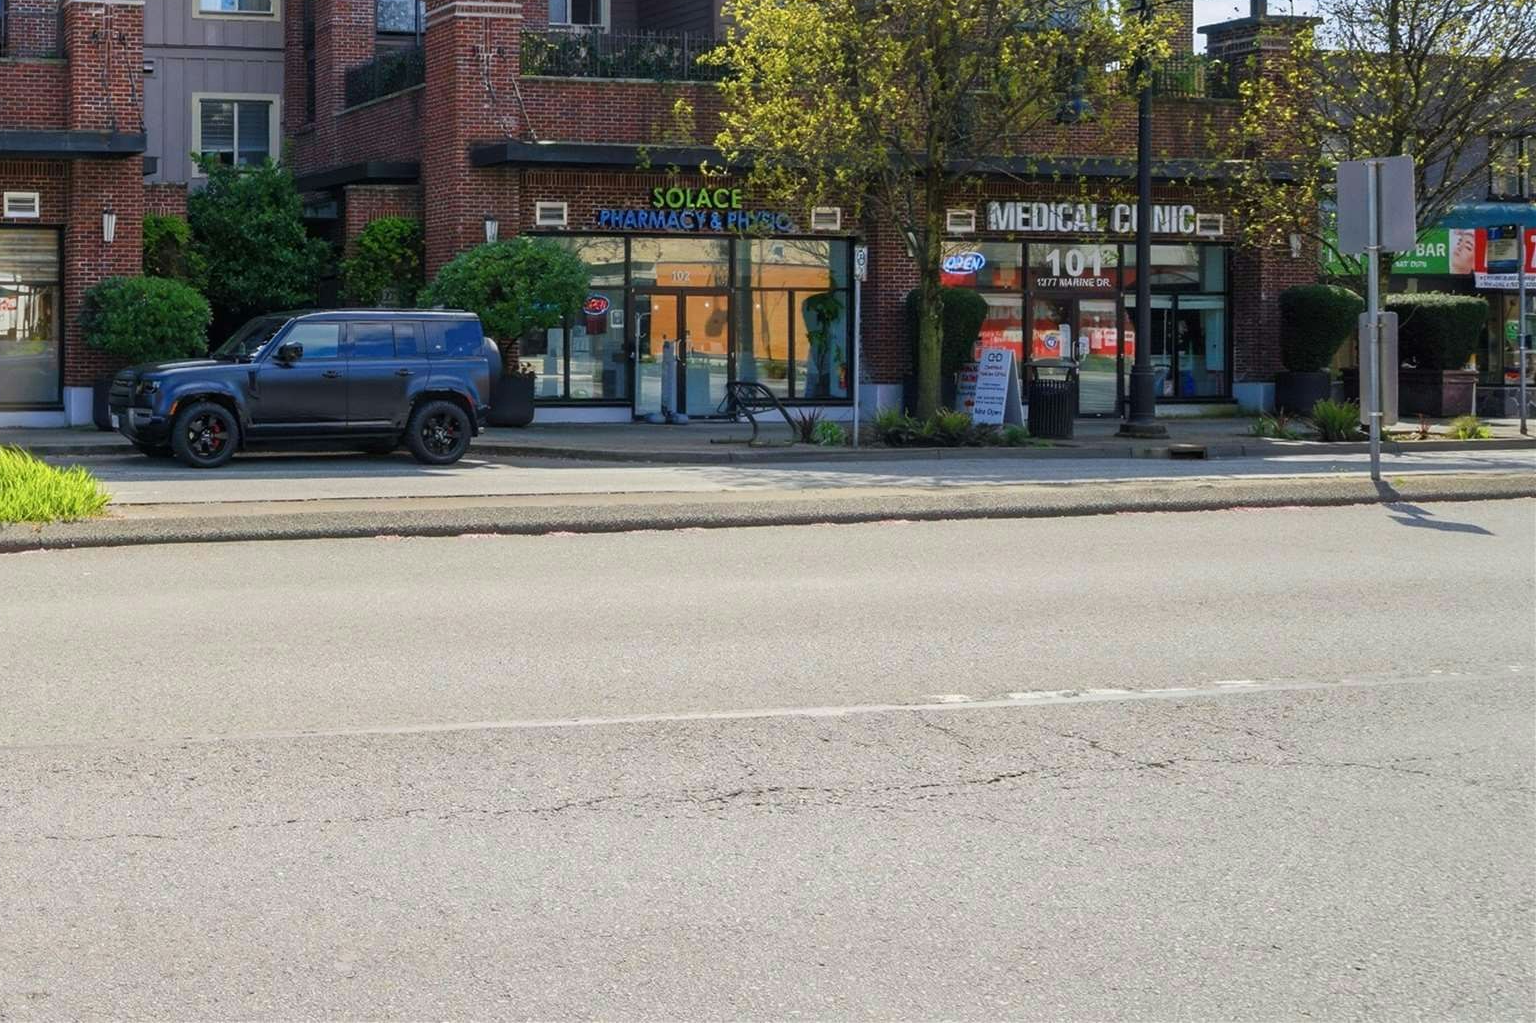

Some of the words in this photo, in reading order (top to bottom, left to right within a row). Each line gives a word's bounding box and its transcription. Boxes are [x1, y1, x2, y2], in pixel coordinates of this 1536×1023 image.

[652, 187, 743, 209] SOLACE
[598, 209, 706, 229] PHARMACY
[710, 209, 722, 230] &
[987, 200, 1105, 232] MEDICAL
[1415, 242, 1446, 257] BAR
[945, 255, 982, 270] OPEN
[1046, 248, 1103, 277] 101
[1058, 278, 1095, 287] MARINE
